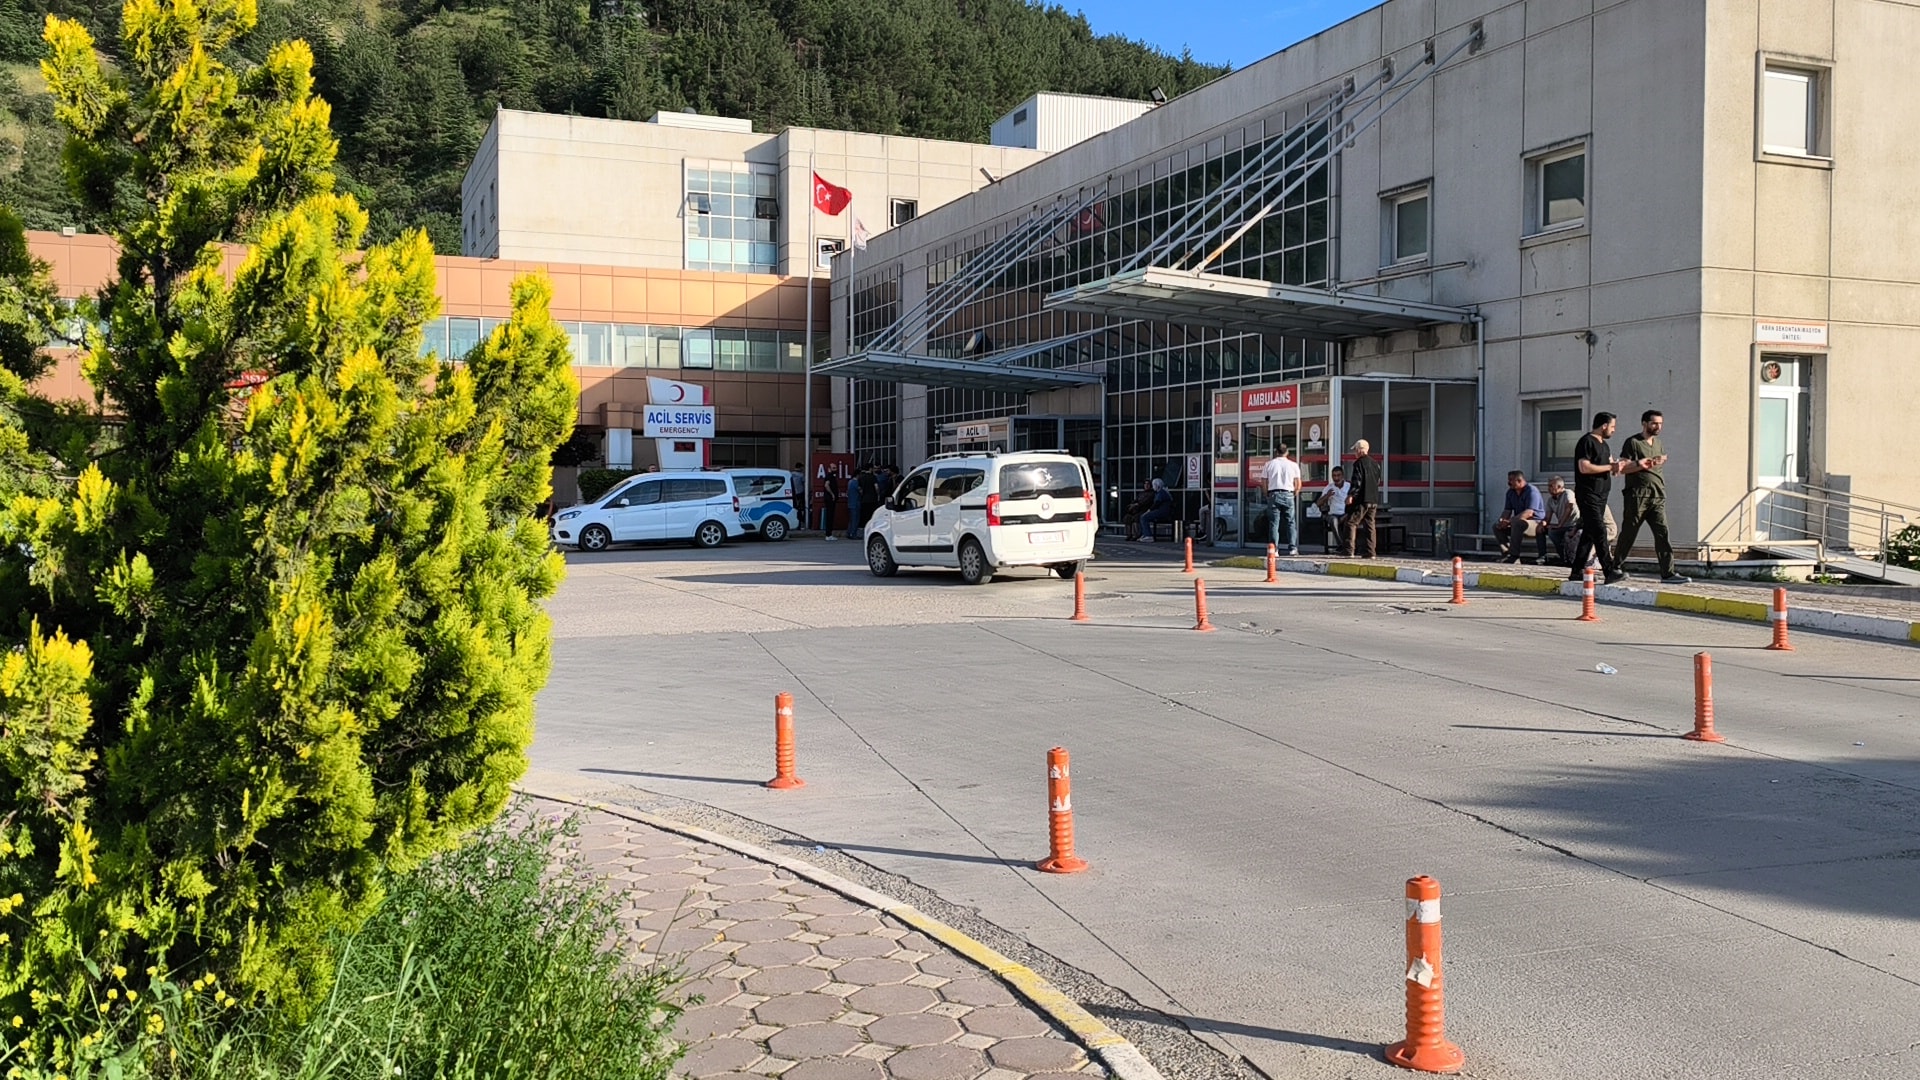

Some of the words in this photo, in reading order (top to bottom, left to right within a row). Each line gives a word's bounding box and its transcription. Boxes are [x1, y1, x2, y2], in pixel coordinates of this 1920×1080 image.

[1247, 389, 1291, 407] AMBULANS
[647, 409, 673, 424] ACİL
[674, 409, 712, 425] SERVİS
[659, 426, 700, 434] EMERGENCY
[965, 425, 980, 437] ACİL
[816, 460, 852, 479] AİL
